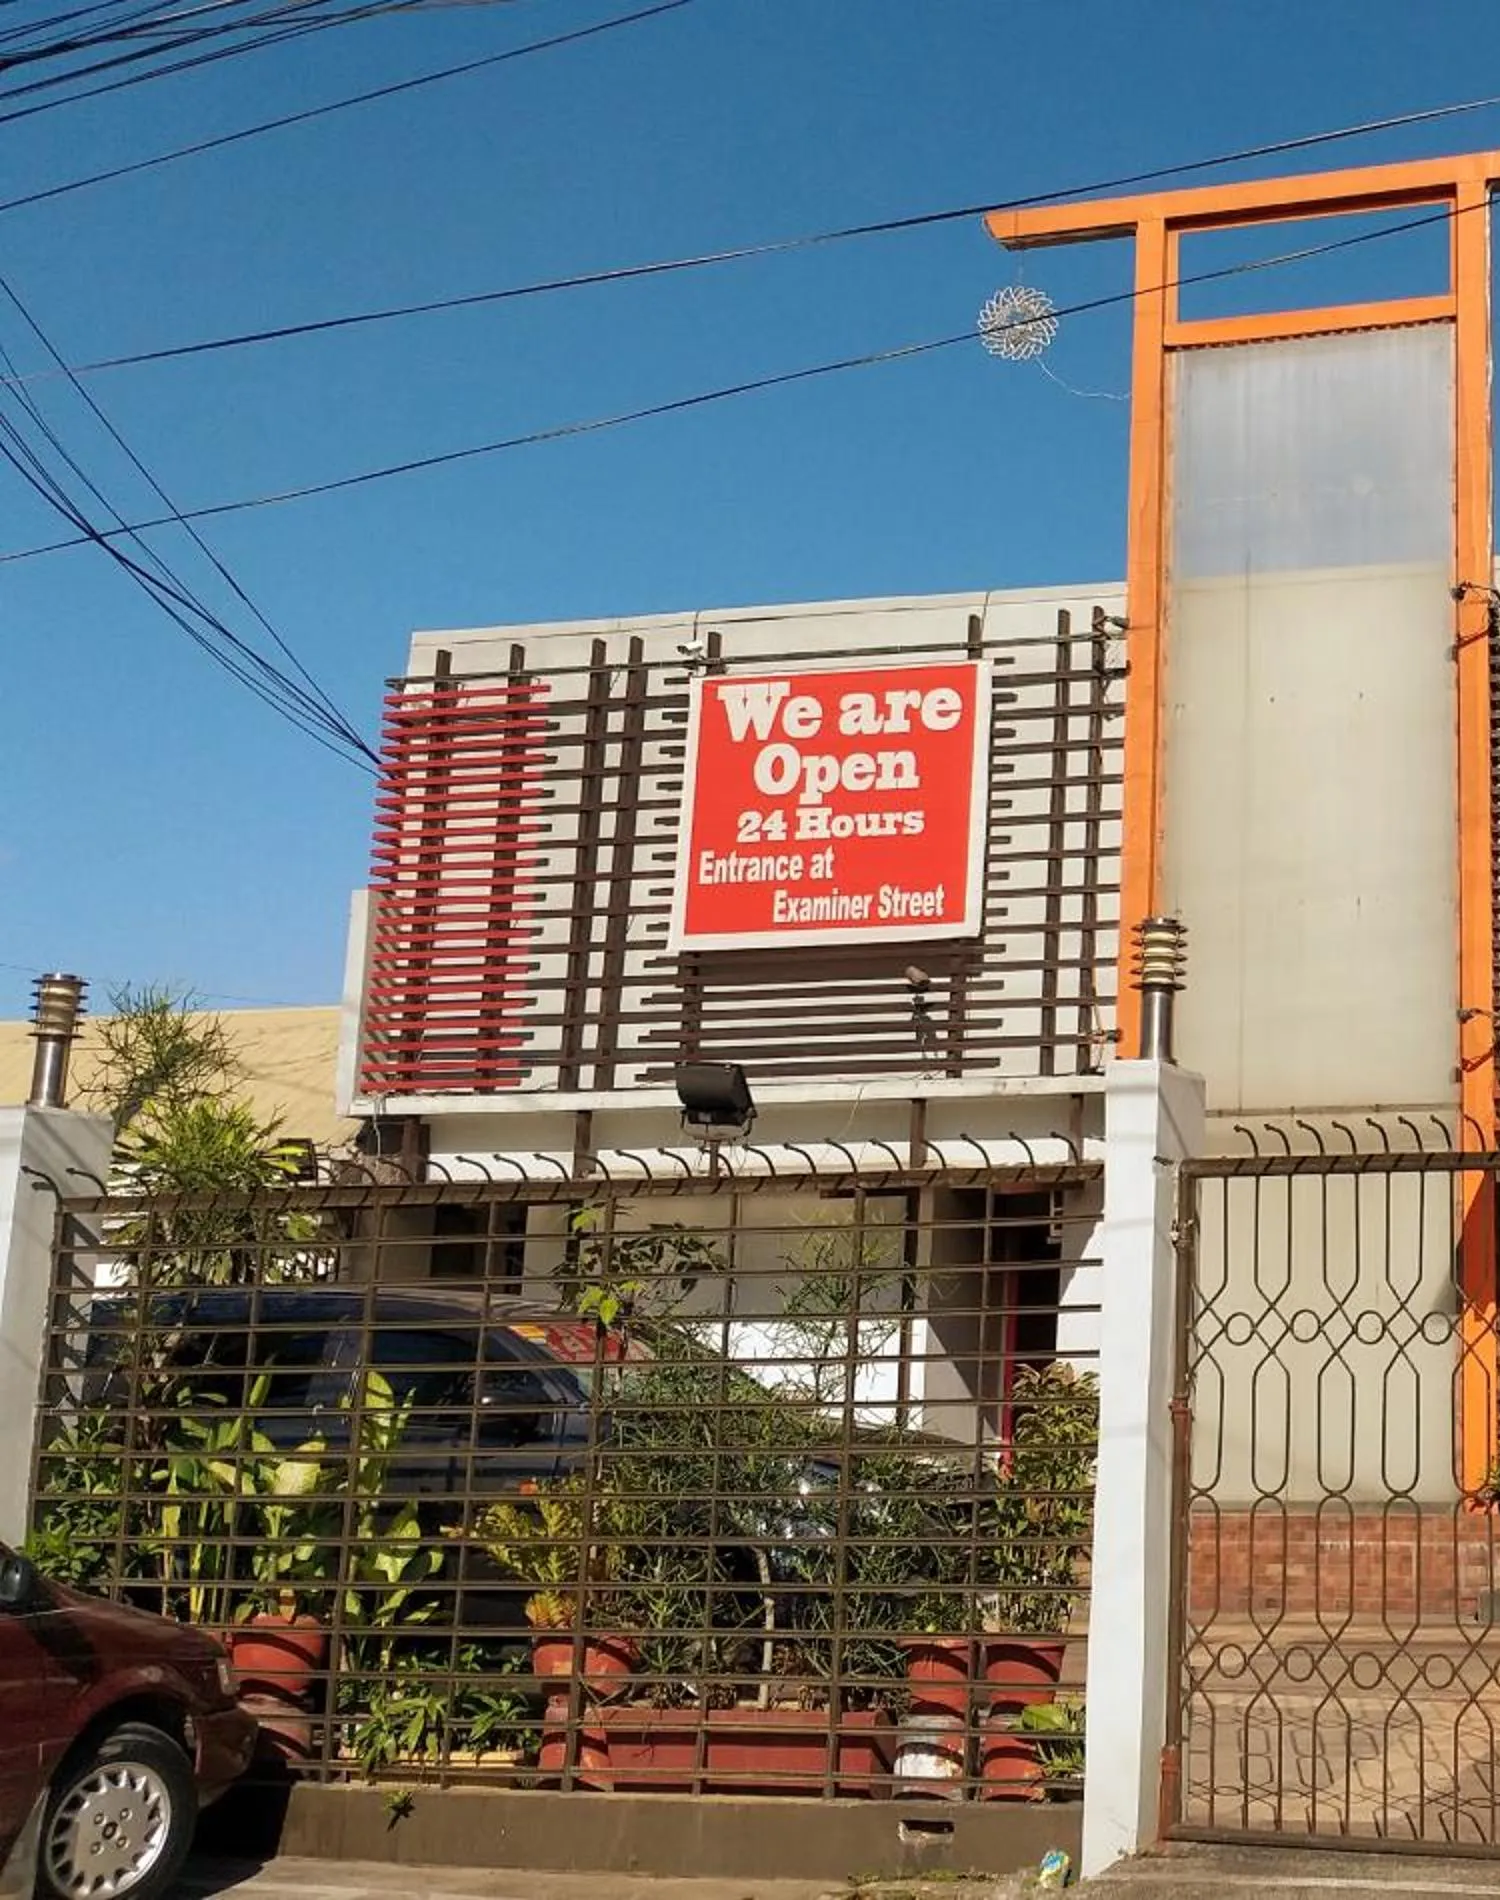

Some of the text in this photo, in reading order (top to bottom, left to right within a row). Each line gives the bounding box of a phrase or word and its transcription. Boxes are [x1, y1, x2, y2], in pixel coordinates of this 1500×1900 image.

[717, 681, 962, 742] We are
[753, 743, 920, 805] Open
[736, 807, 925, 843] 24 Hours
[699, 845, 835, 884] Entrance at
[773, 883, 945, 923] Examiner Street
